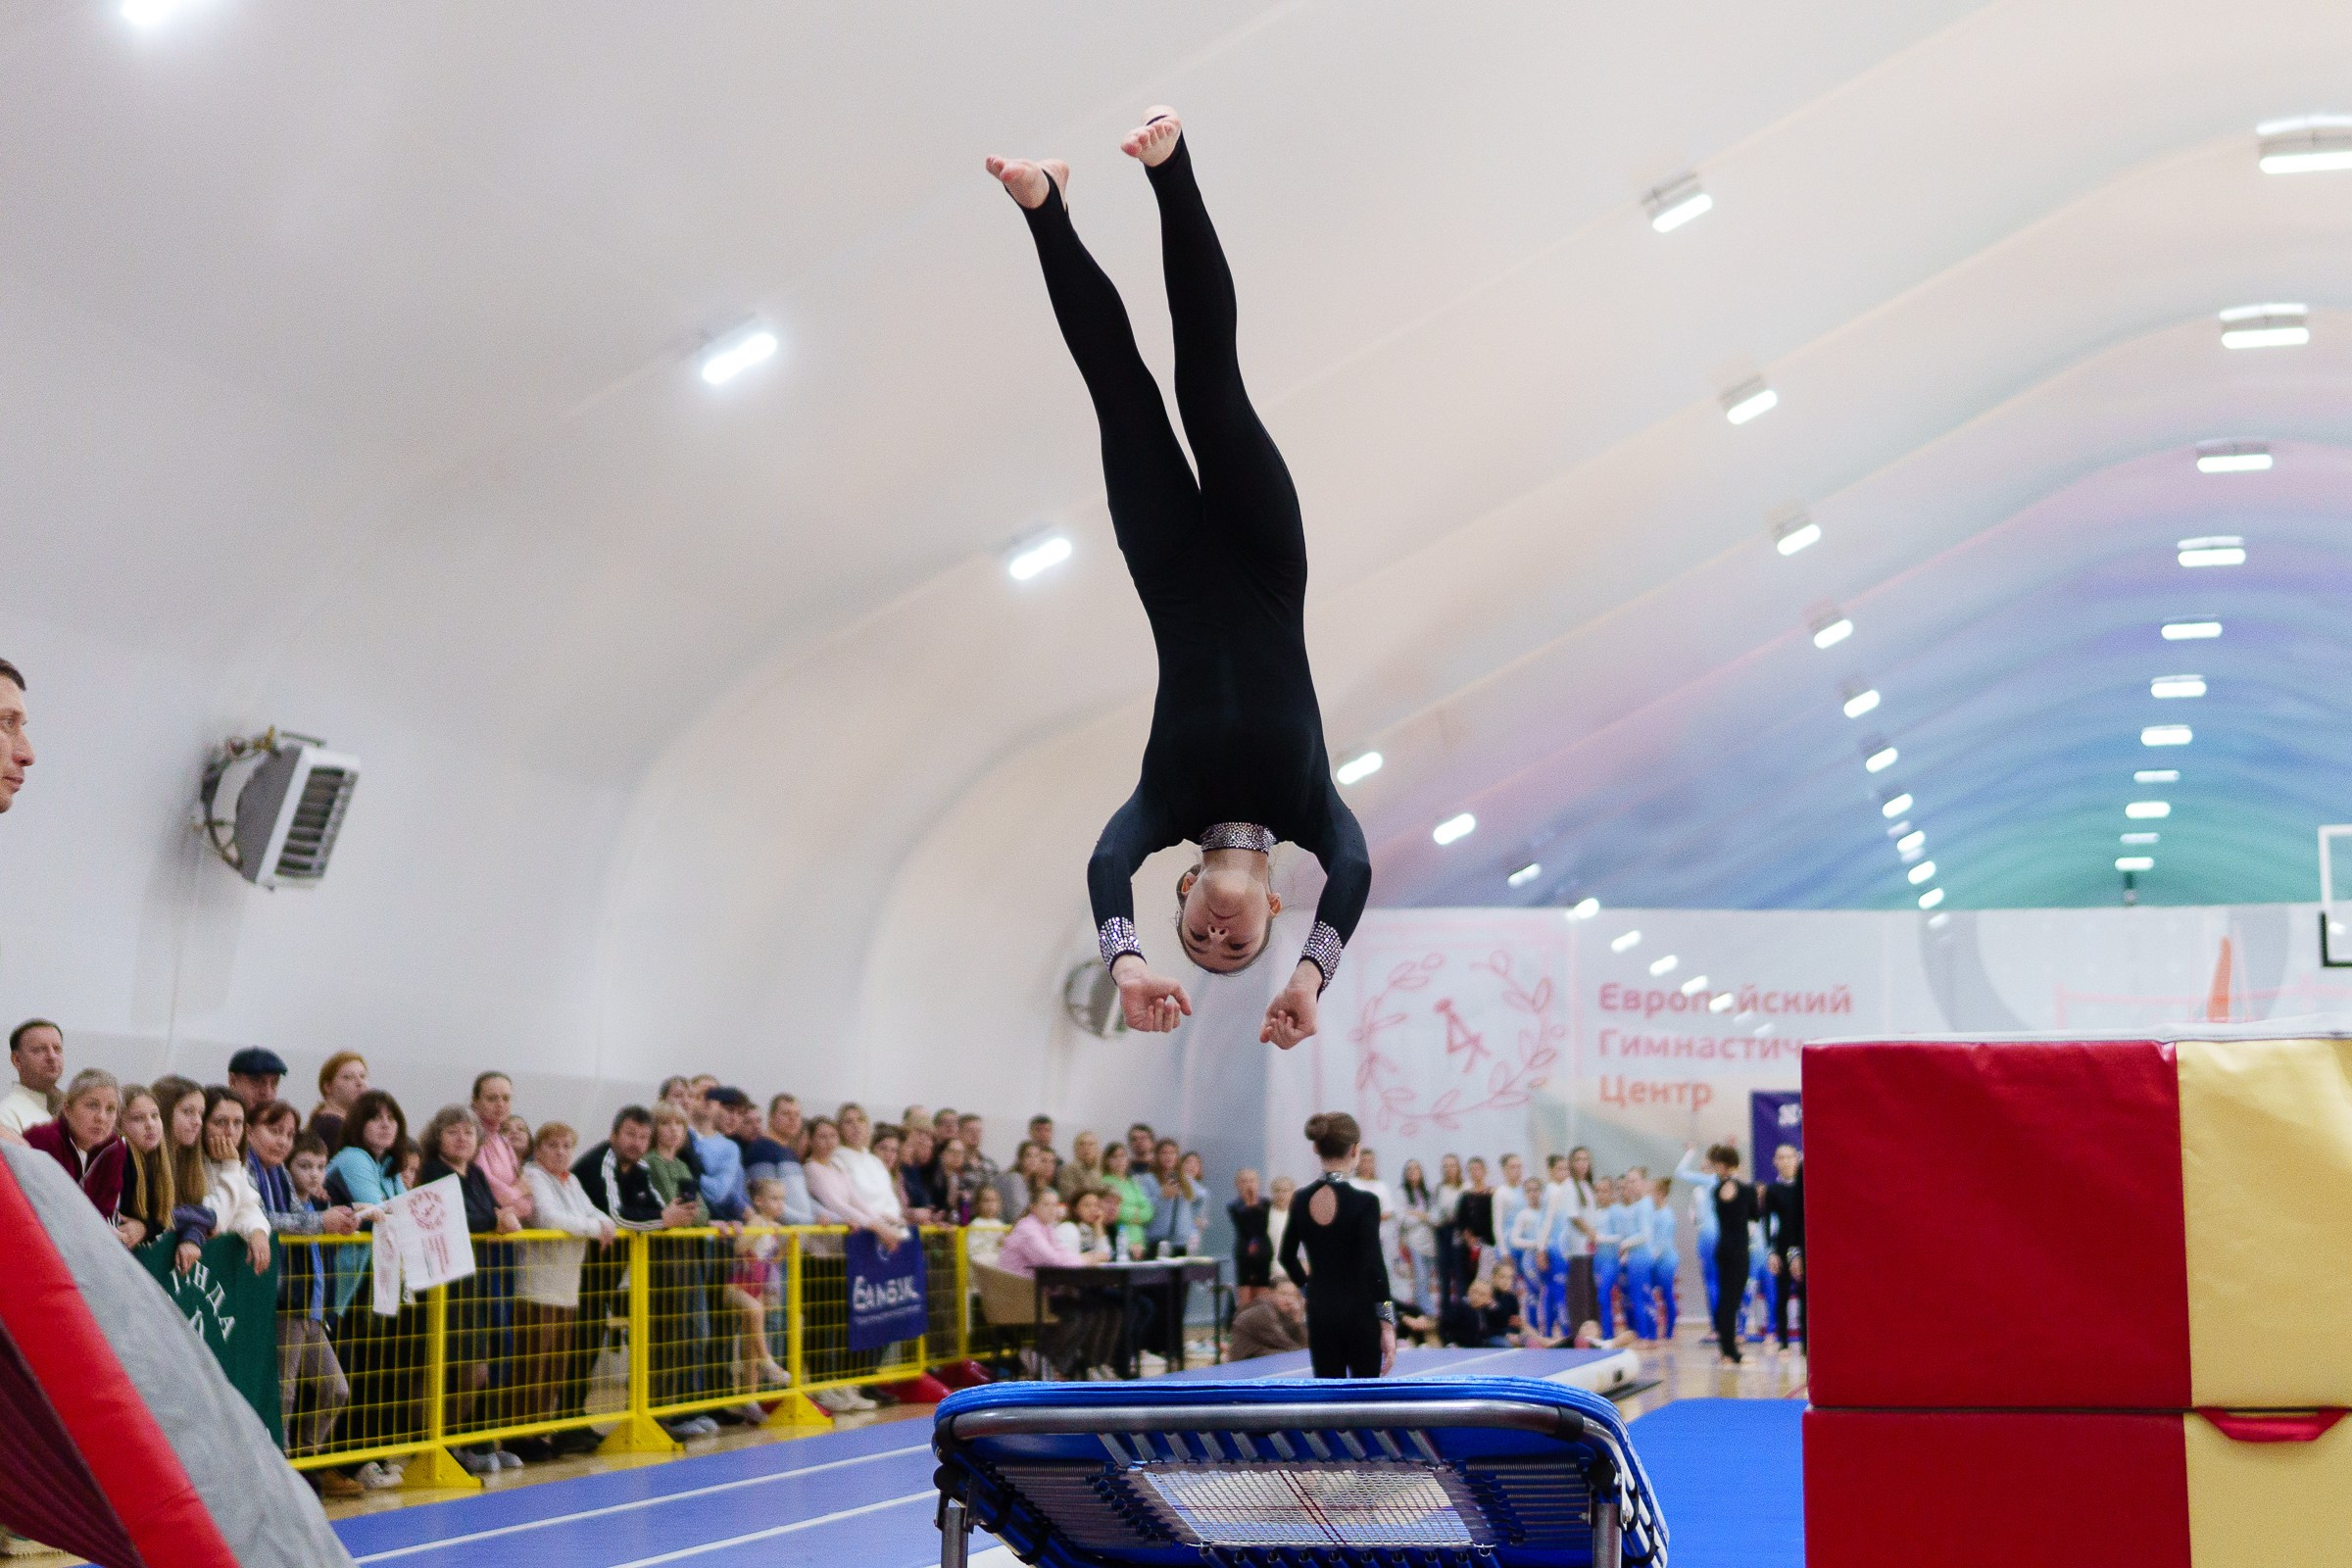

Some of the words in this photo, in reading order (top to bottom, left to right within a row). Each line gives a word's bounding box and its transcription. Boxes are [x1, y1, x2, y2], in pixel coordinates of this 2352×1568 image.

[1598, 982, 1852, 1019] Европйский
[1598, 1028, 1802, 1060] Гимнастич
[1599, 1074, 1713, 1112] Центр
